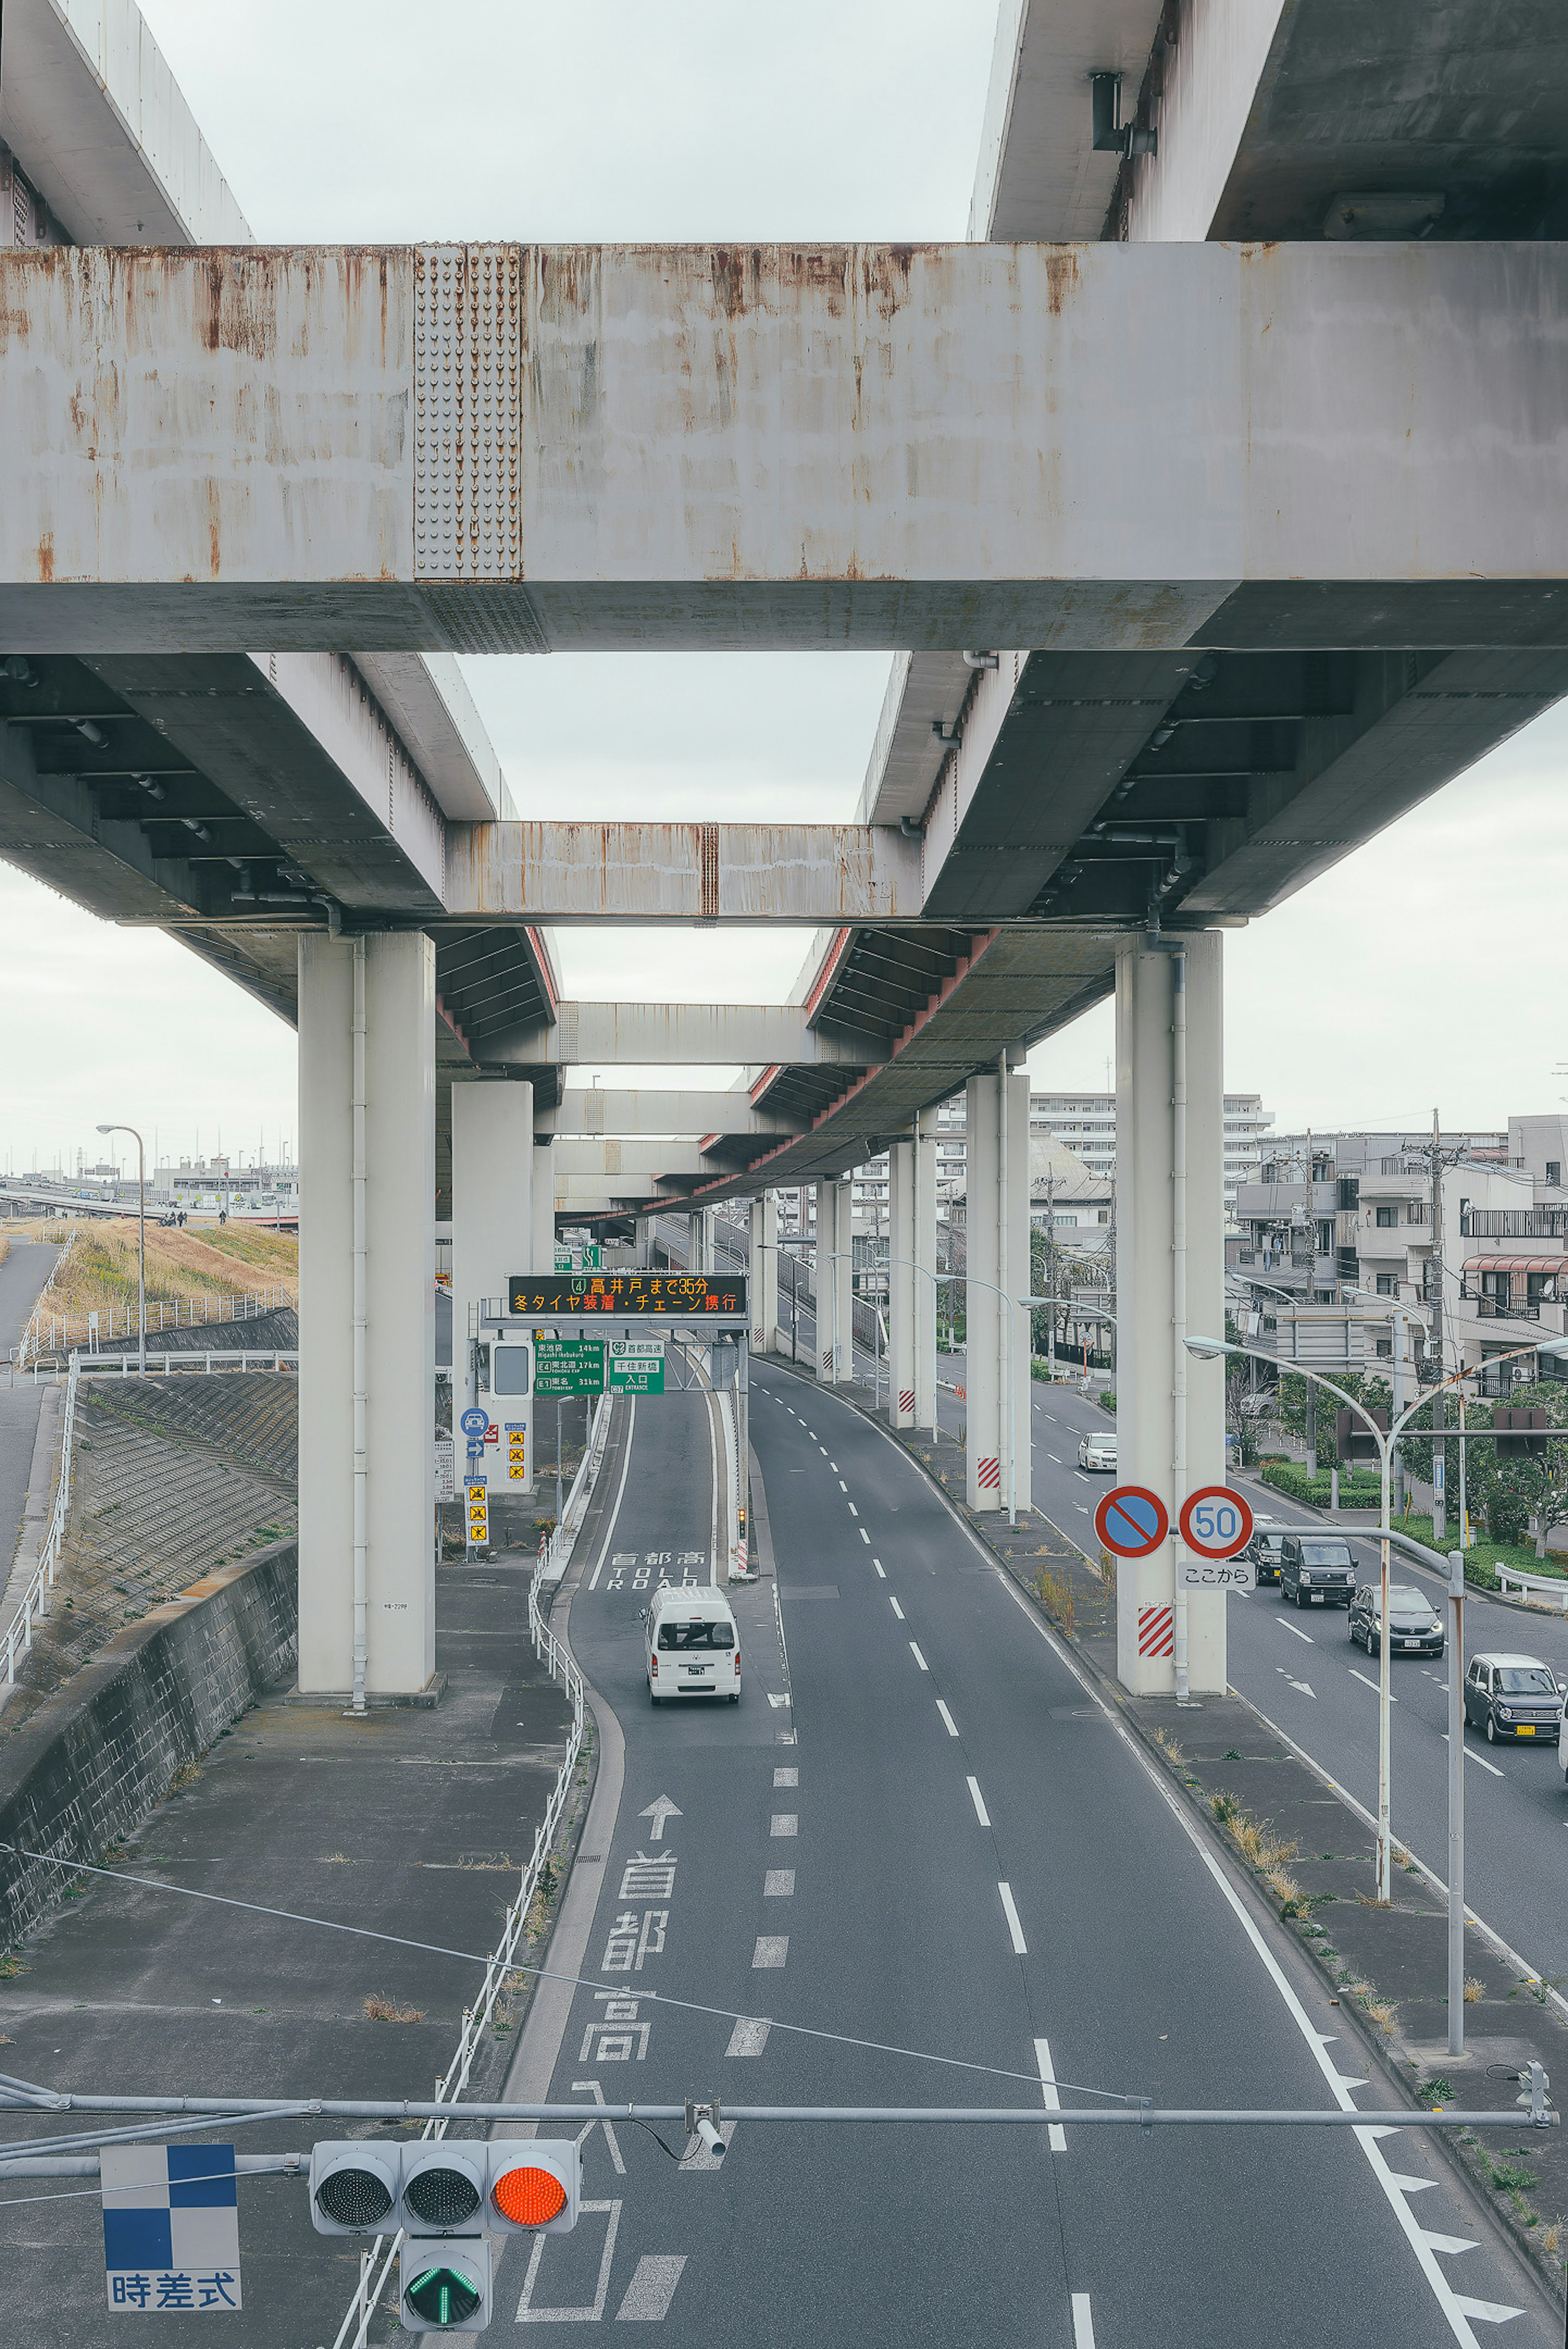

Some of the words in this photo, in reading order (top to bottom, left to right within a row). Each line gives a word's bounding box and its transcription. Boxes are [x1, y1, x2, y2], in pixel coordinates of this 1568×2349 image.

[591, 1277, 709, 1295] 高井戸まで35分
[514, 1294, 737, 1311] 冬タイヤ装着・チェーン携行
[628, 1344, 662, 1353] 首都高速
[617, 1362, 657, 1371] 千住新橋
[626, 1374, 648, 1384] 入口
[1196, 1507, 1236, 1538] 50
[612, 1551, 706, 1566] 首都高
[612, 1567, 698, 1578] TOLL
[1185, 1569, 1249, 1584] ここから
[606, 1579, 699, 1590] ROAD
[113, 2272, 236, 2308] 時差式
